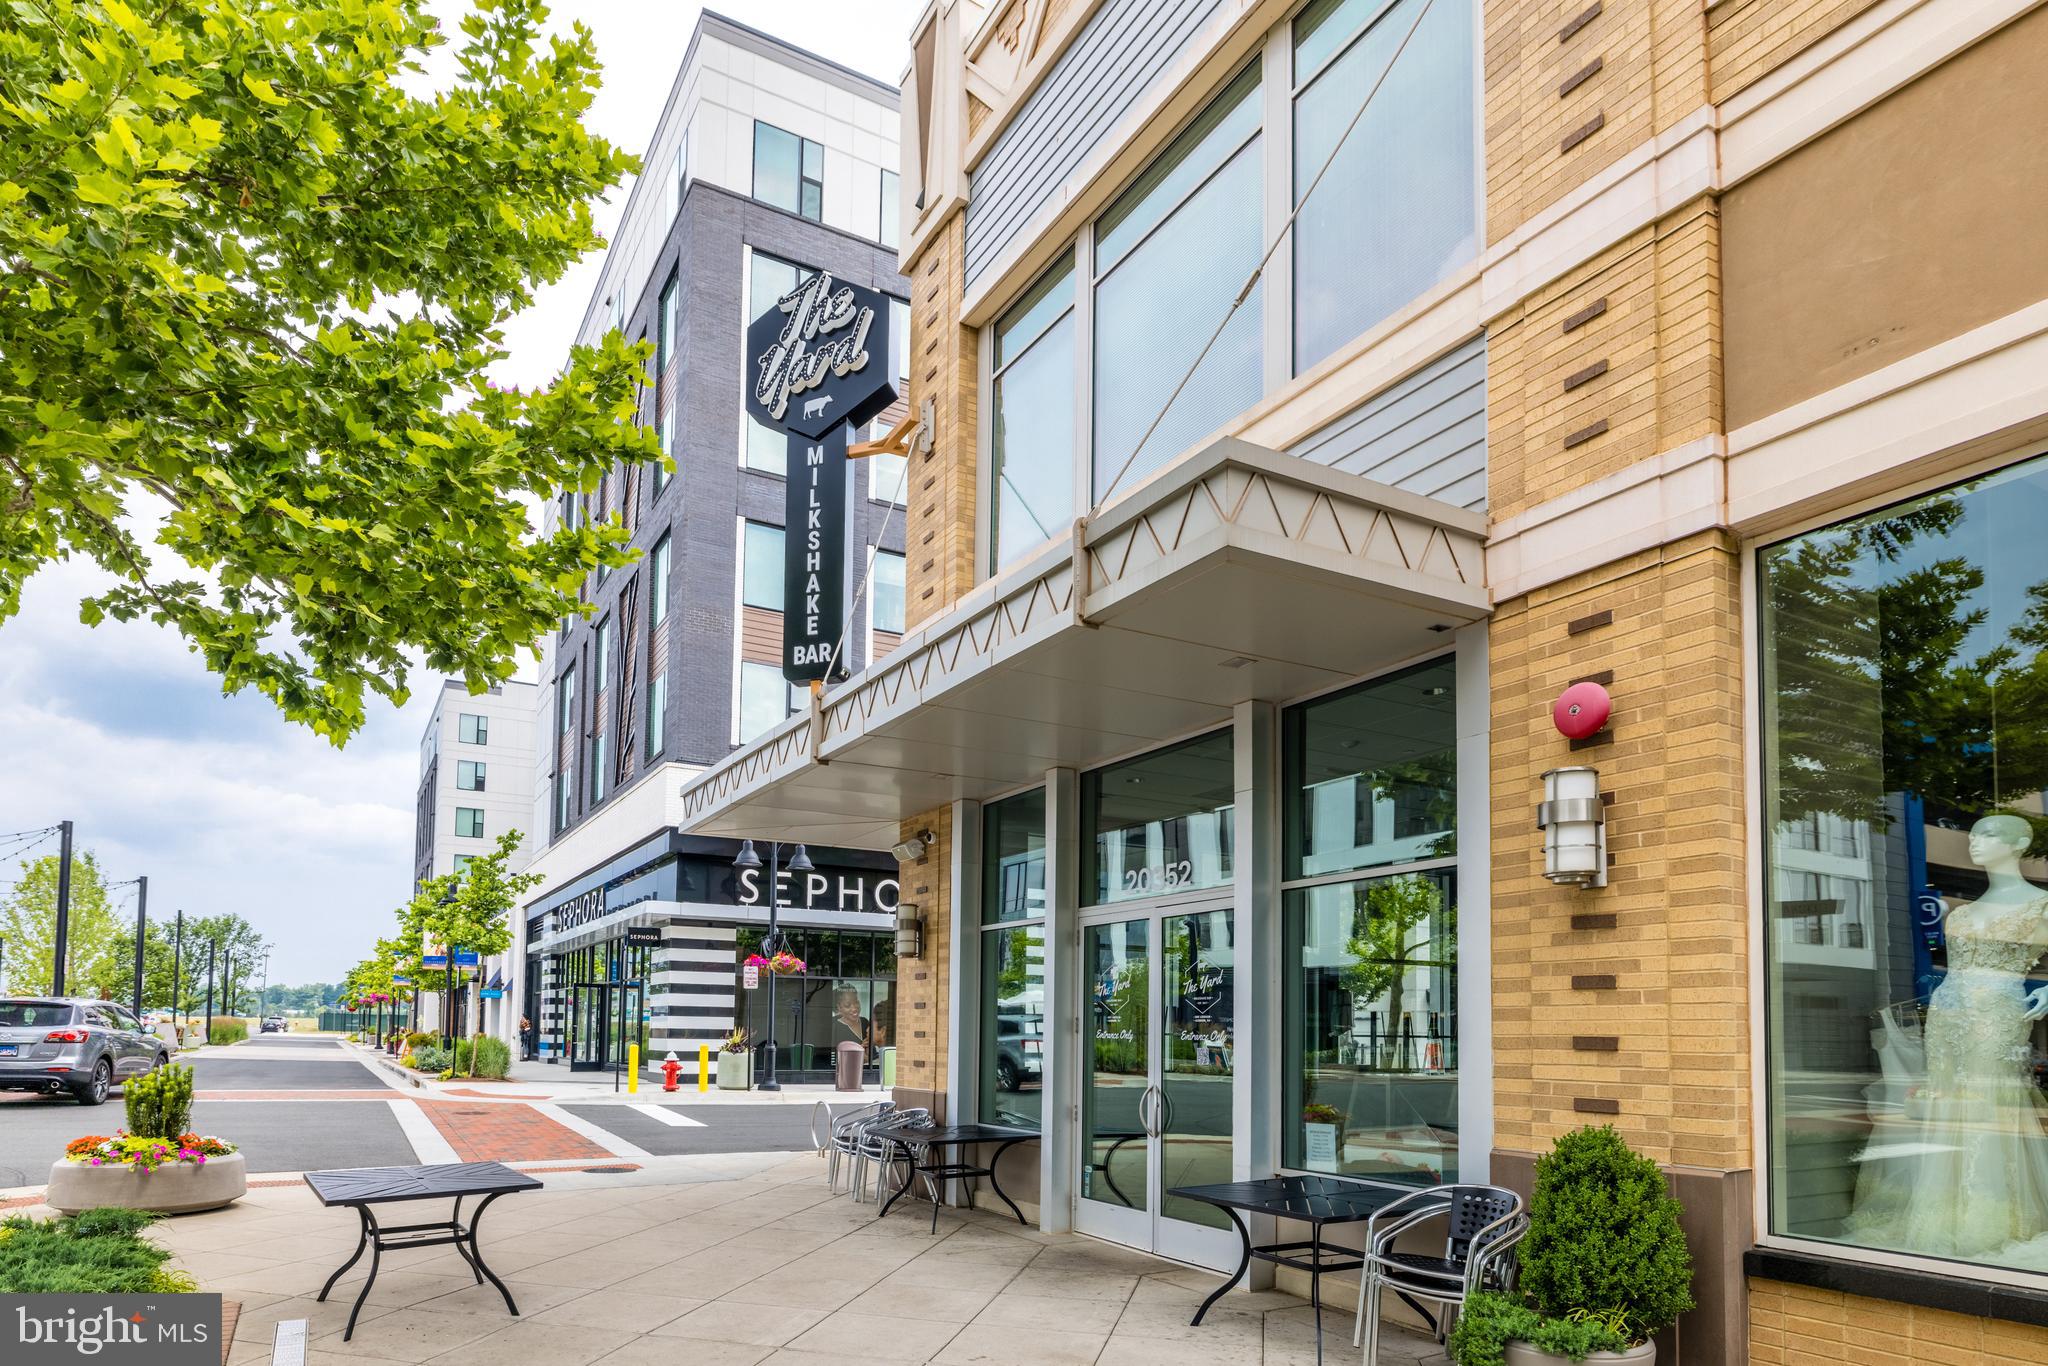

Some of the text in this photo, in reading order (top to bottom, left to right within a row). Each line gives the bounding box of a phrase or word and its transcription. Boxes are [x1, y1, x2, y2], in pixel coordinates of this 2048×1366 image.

[777, 273, 856, 343] The
[756, 306, 874, 420] Yard
[806, 445, 824, 636] MILKSHAKE
[793, 643, 832, 666] BAR
[558, 887, 606, 933] SEPHORA
[629, 933, 659, 941] SEPHORA
[1183, 969, 1224, 995] The Yard
